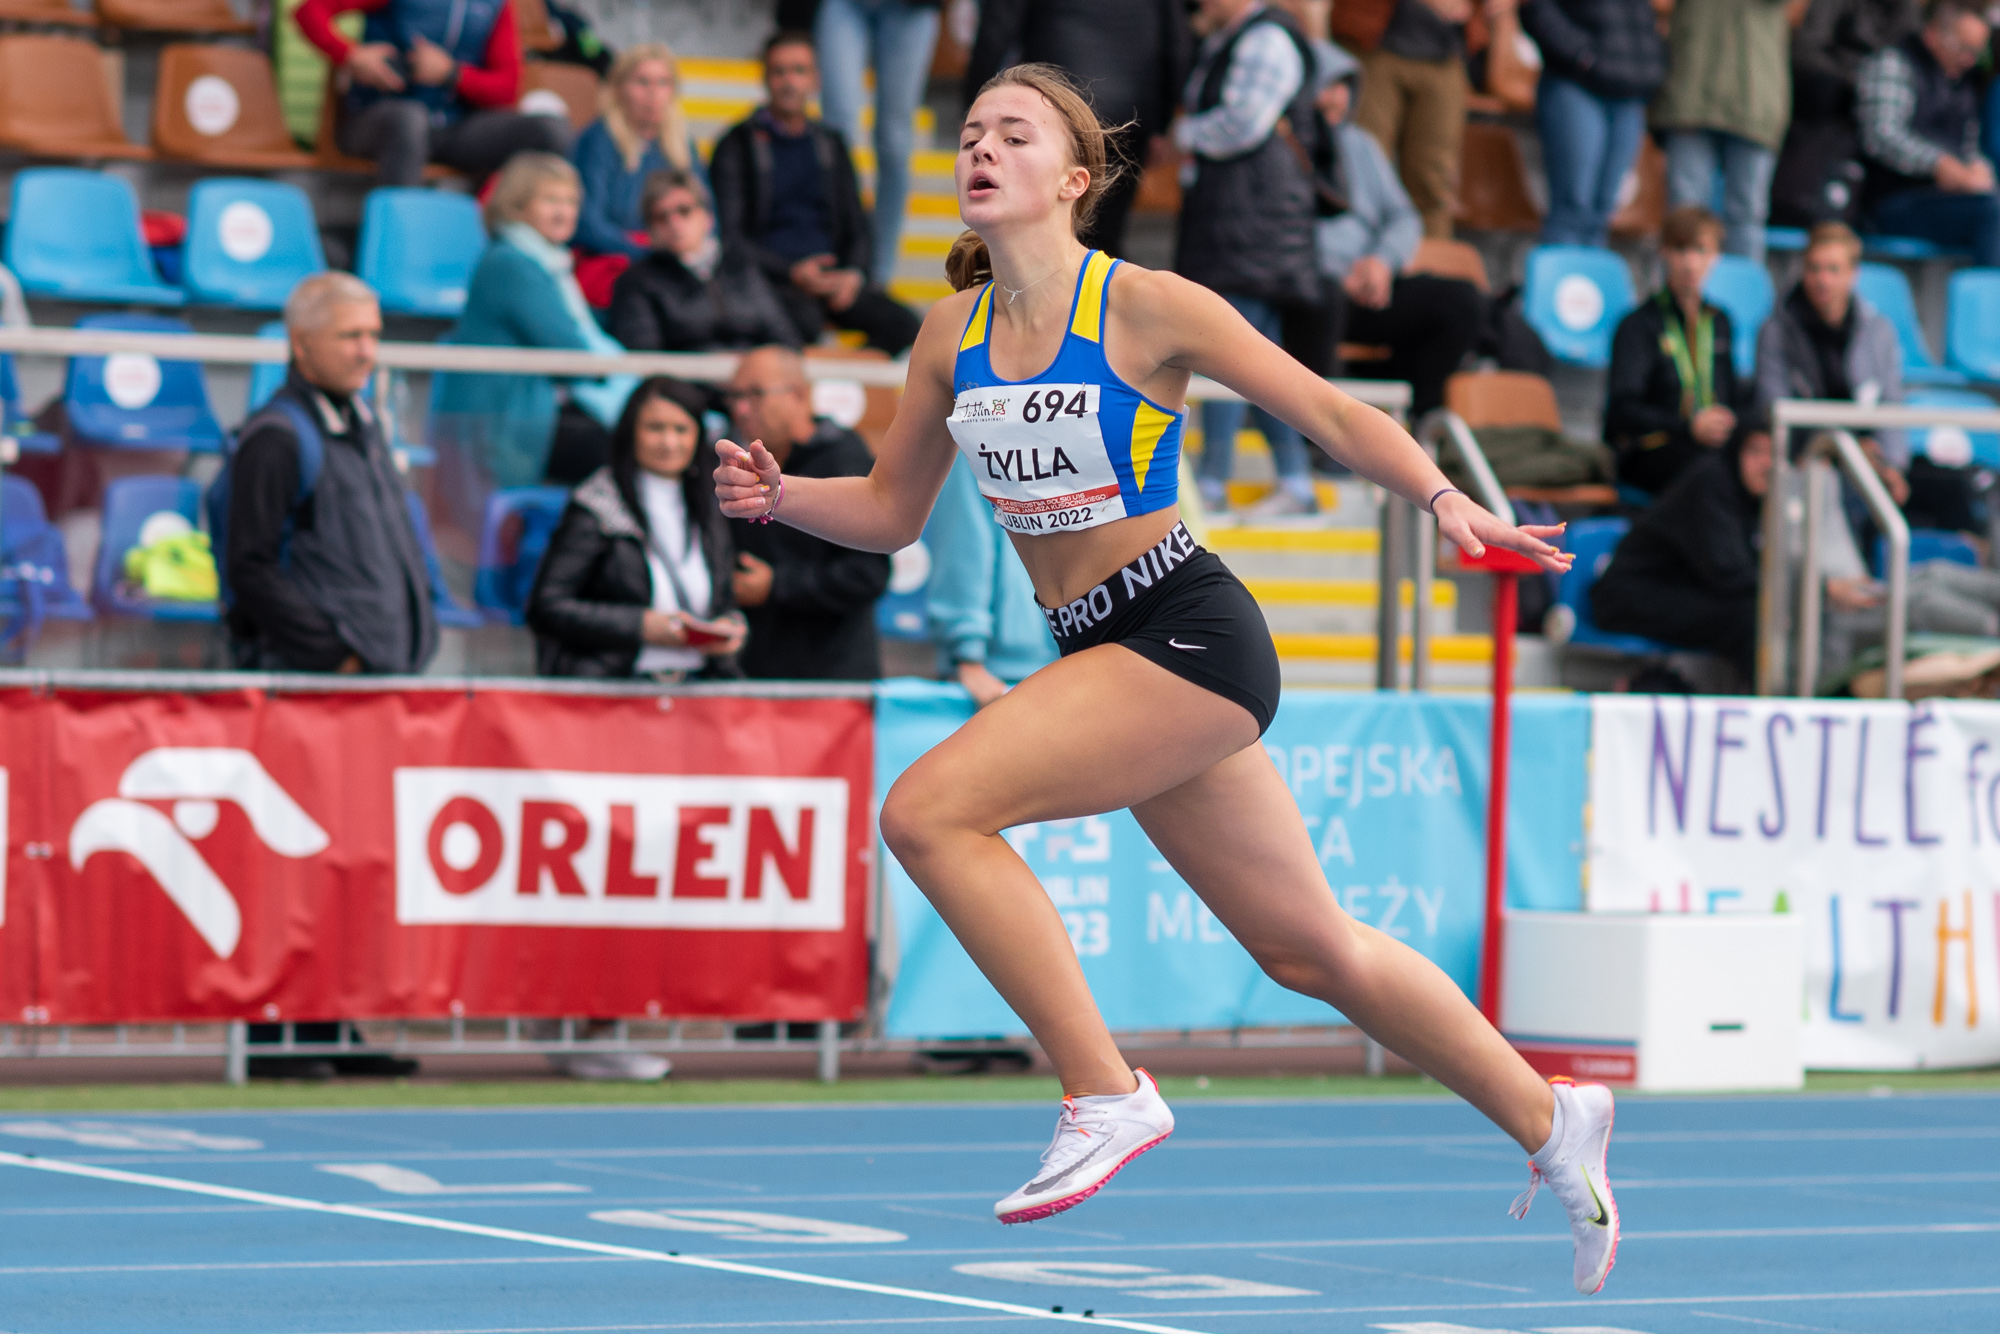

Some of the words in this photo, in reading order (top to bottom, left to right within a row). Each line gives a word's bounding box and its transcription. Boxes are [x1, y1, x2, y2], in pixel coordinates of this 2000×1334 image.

[1022, 389, 1088, 424] 694
[978, 443, 1080, 482] ŻYLLA
[1046, 495, 1071, 505] POLSKI
[1047, 507, 1093, 528] 2022
[1121, 522, 1195, 600] NIKE
[426, 794, 817, 905] ORLEN
